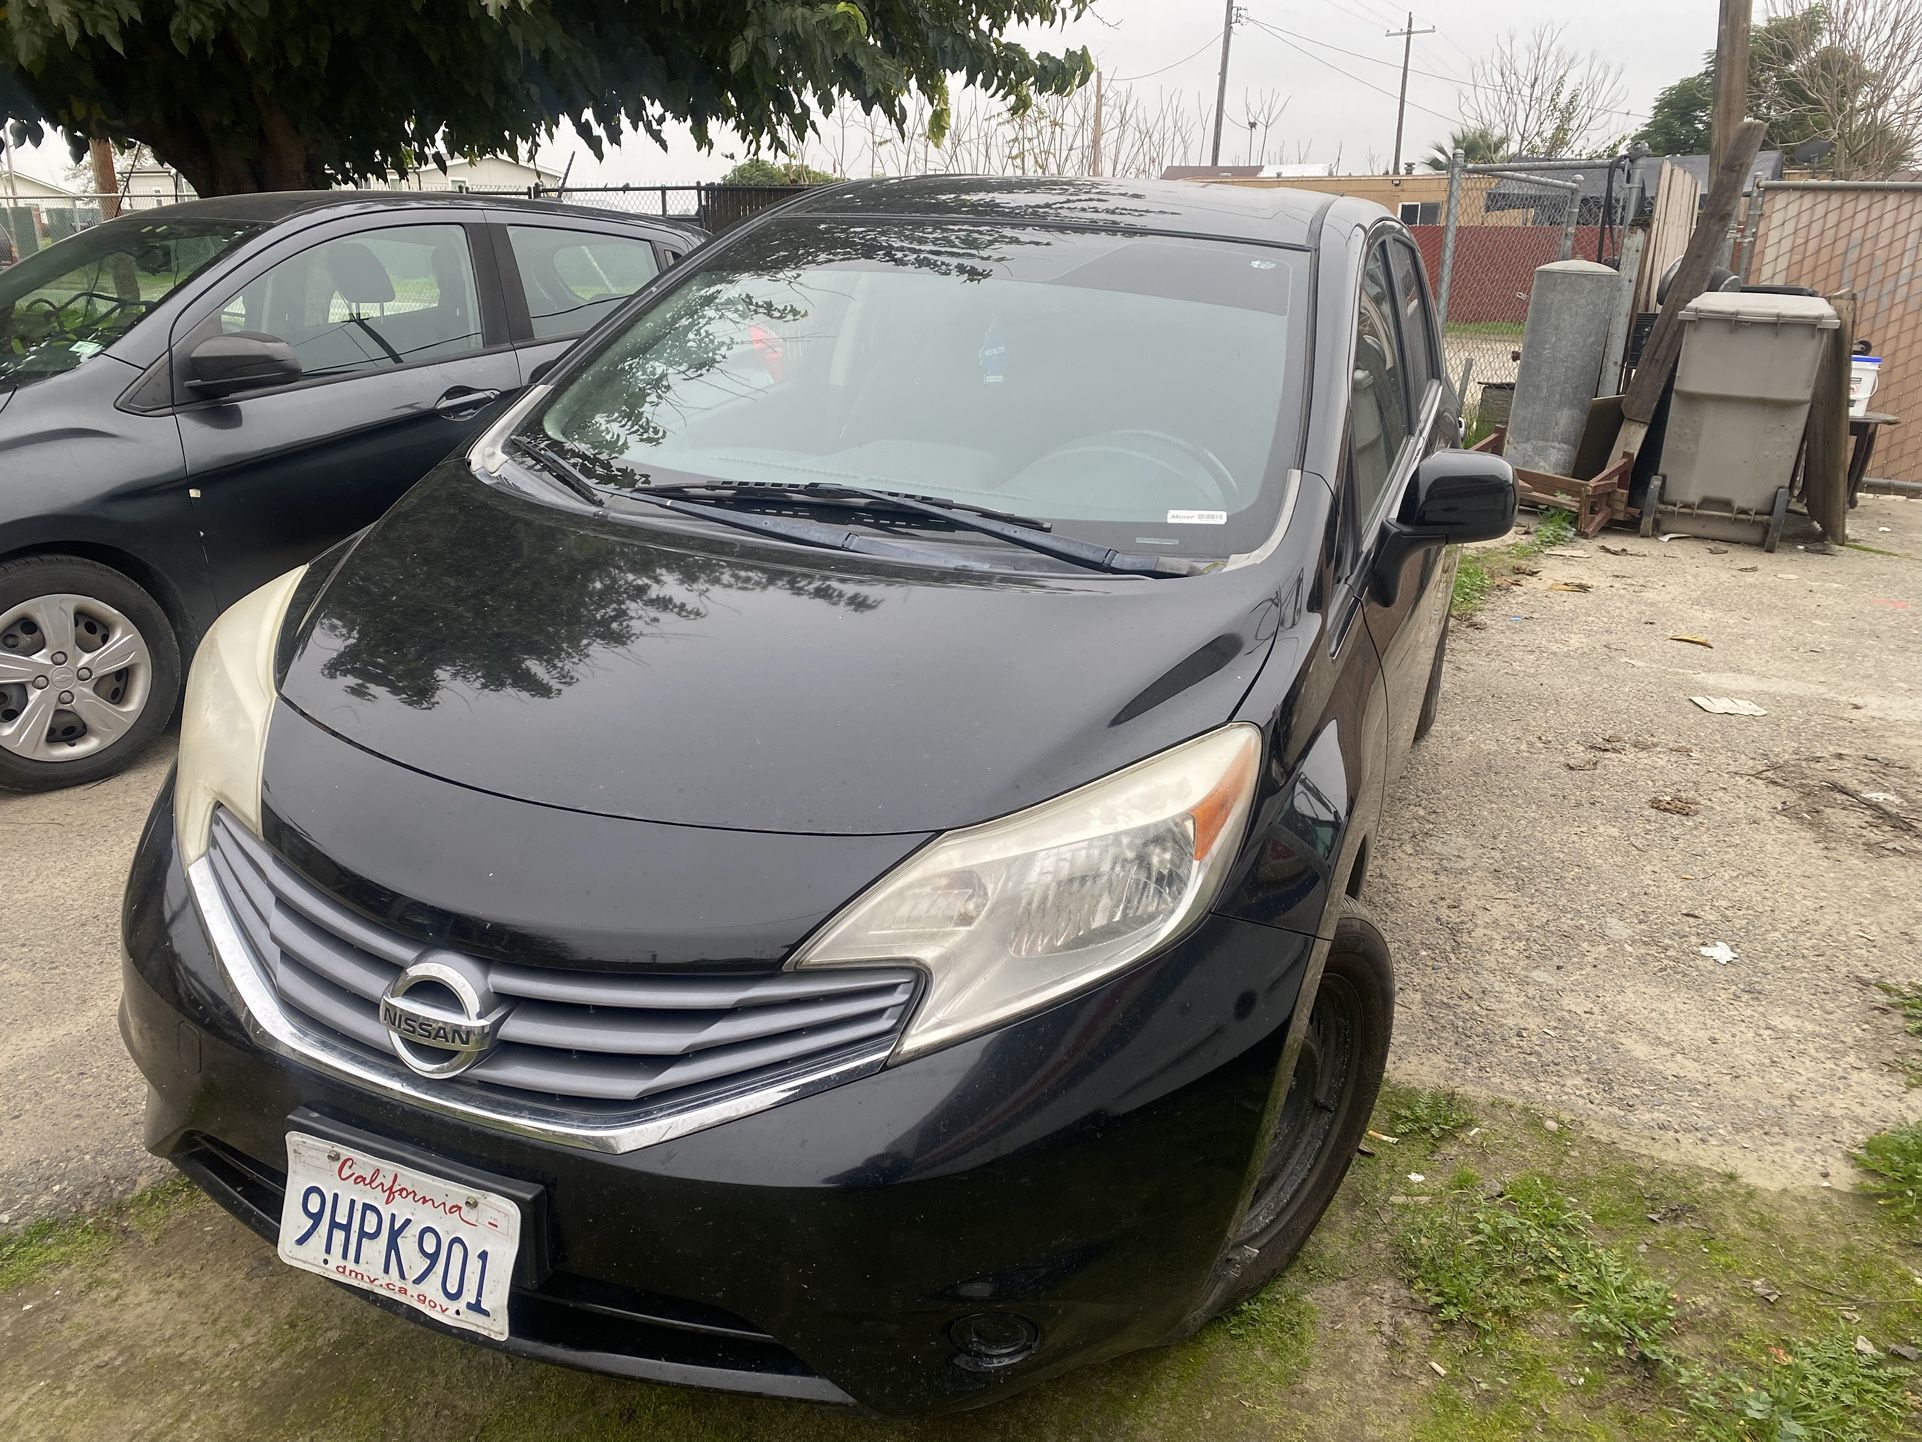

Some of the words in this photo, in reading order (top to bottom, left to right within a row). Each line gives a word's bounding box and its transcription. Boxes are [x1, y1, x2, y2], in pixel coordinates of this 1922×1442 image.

[384, 1007, 472, 1045] NISSAN
[337, 1157, 477, 1227] California
[294, 1185, 491, 1317] 9HPK901
[335, 1263, 449, 1314] dmv.ca.gov
